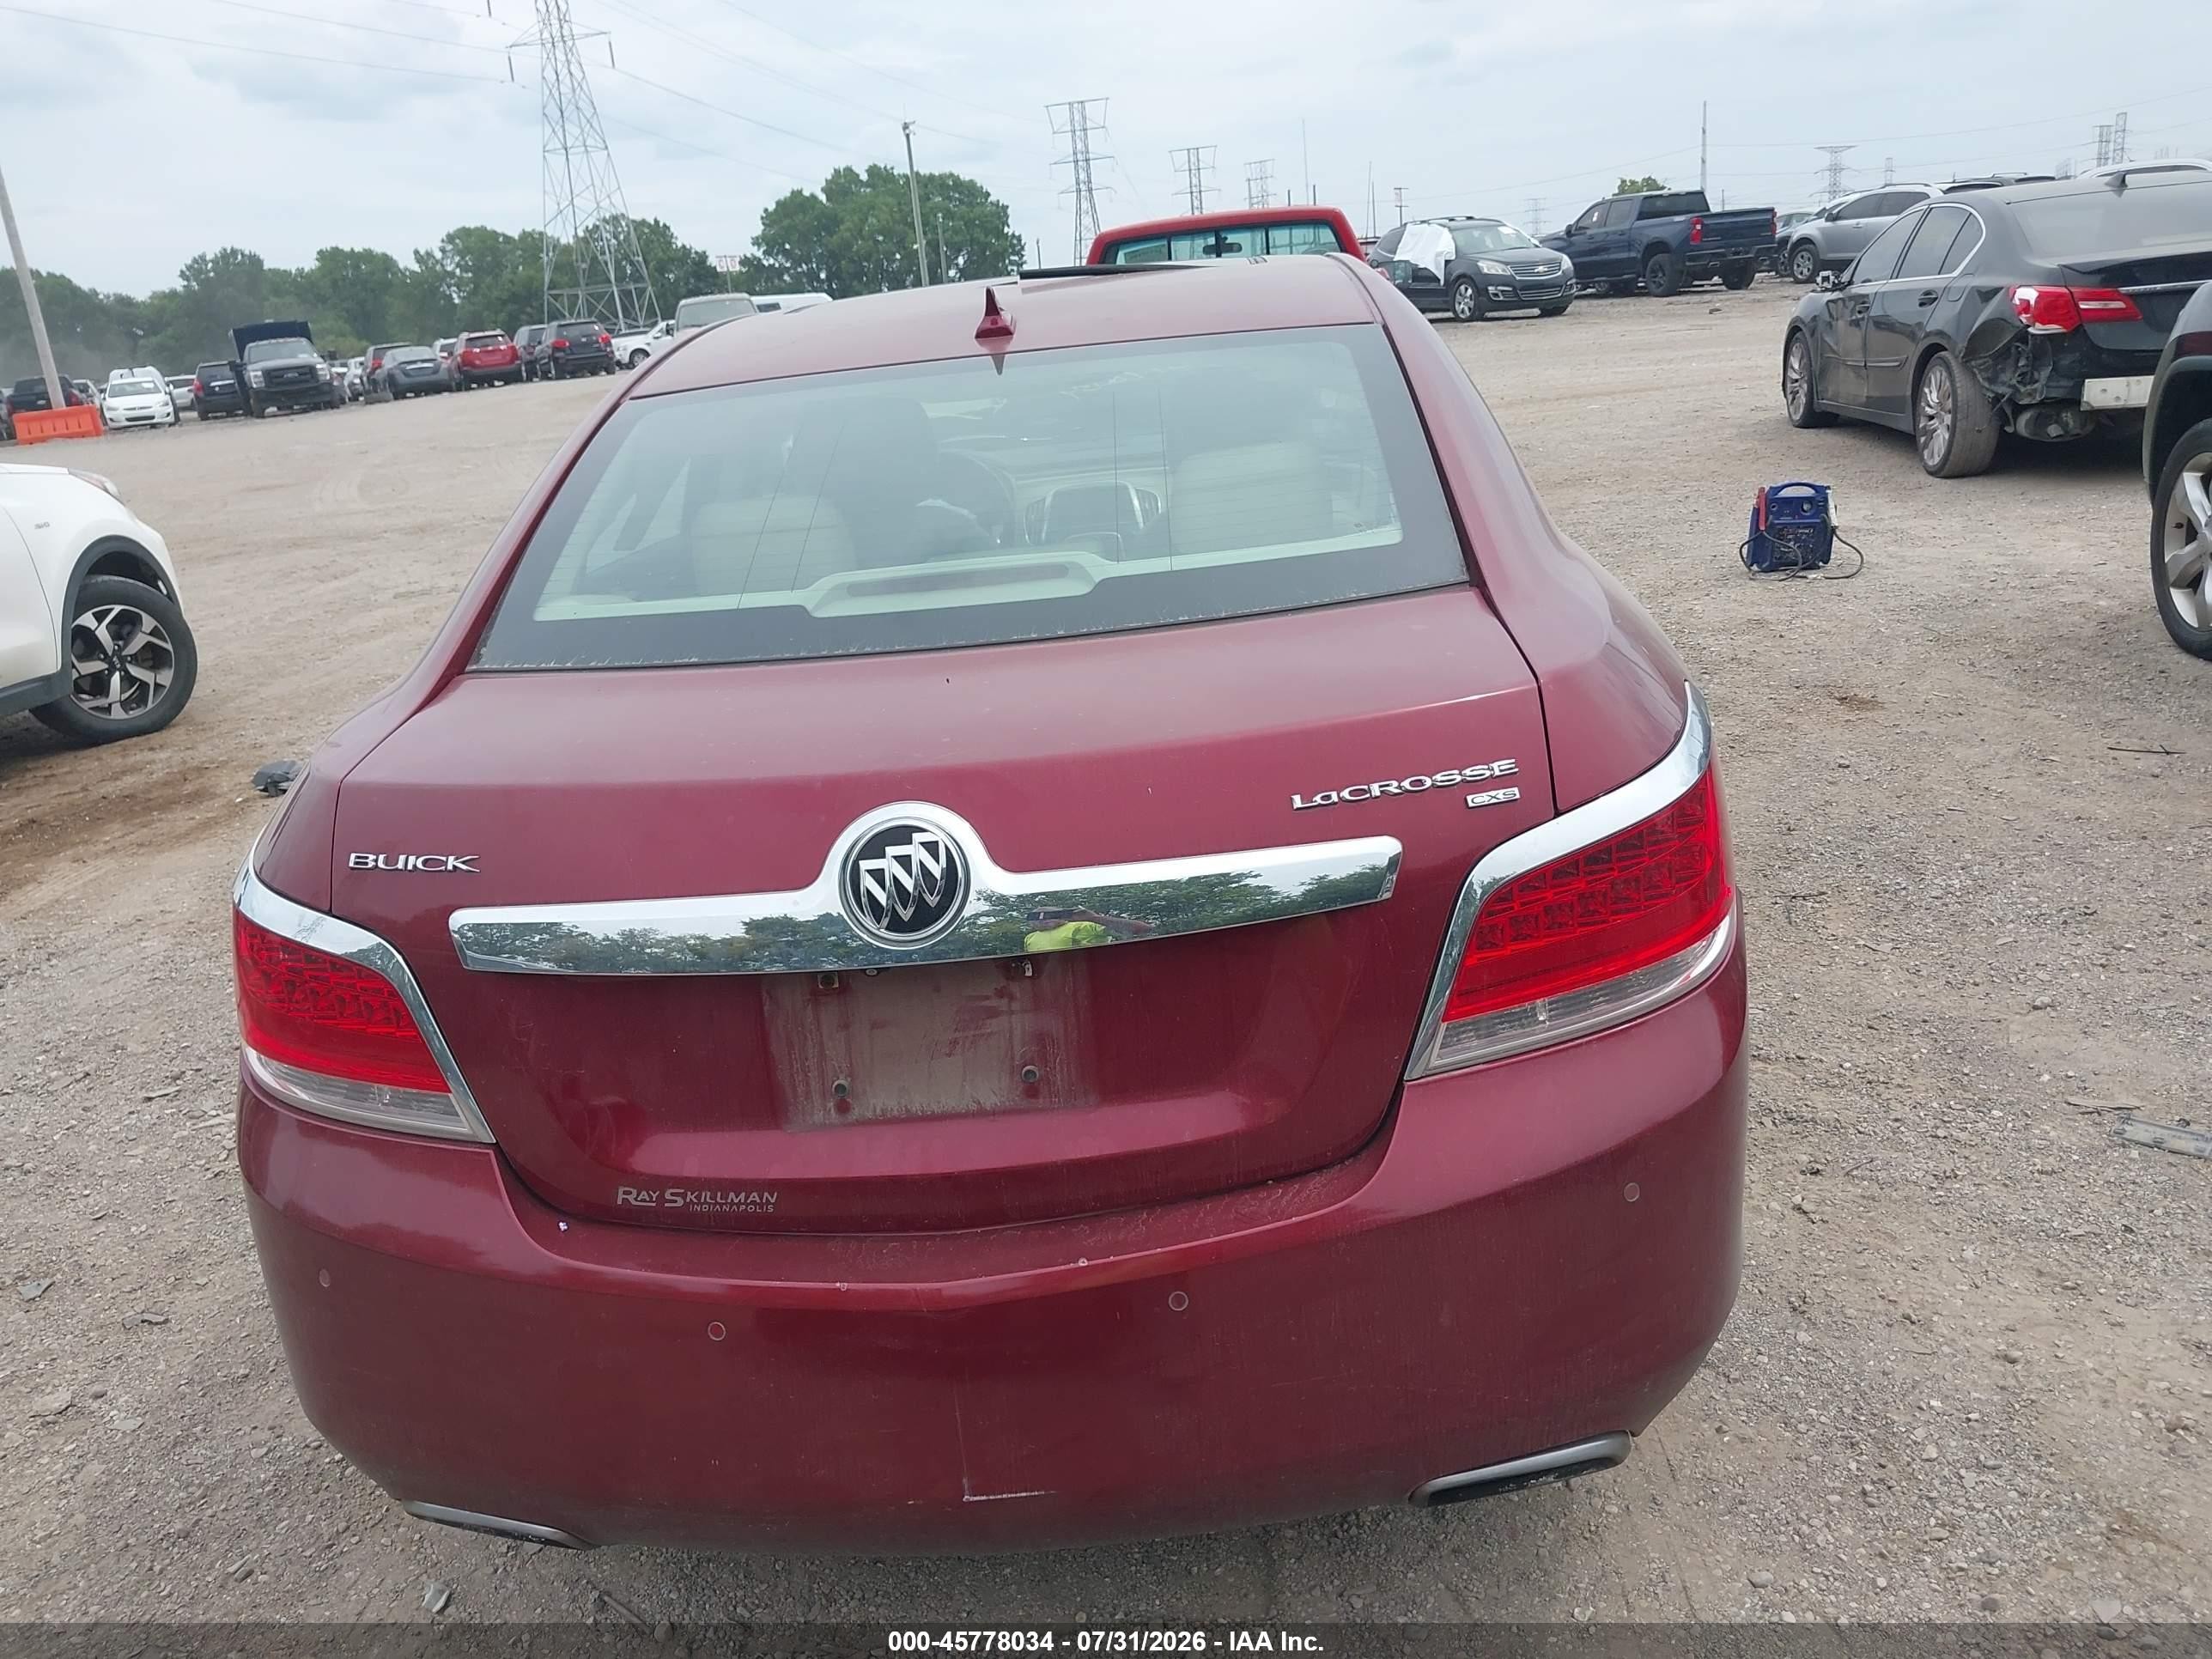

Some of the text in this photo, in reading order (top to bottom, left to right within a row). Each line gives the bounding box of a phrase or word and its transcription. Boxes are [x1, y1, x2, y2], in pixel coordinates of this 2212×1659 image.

[1469, 789, 1518, 807] CXS
[348, 852, 481, 872] BUICK
[689, 1204, 775, 1213] INDIANAPOLIS
